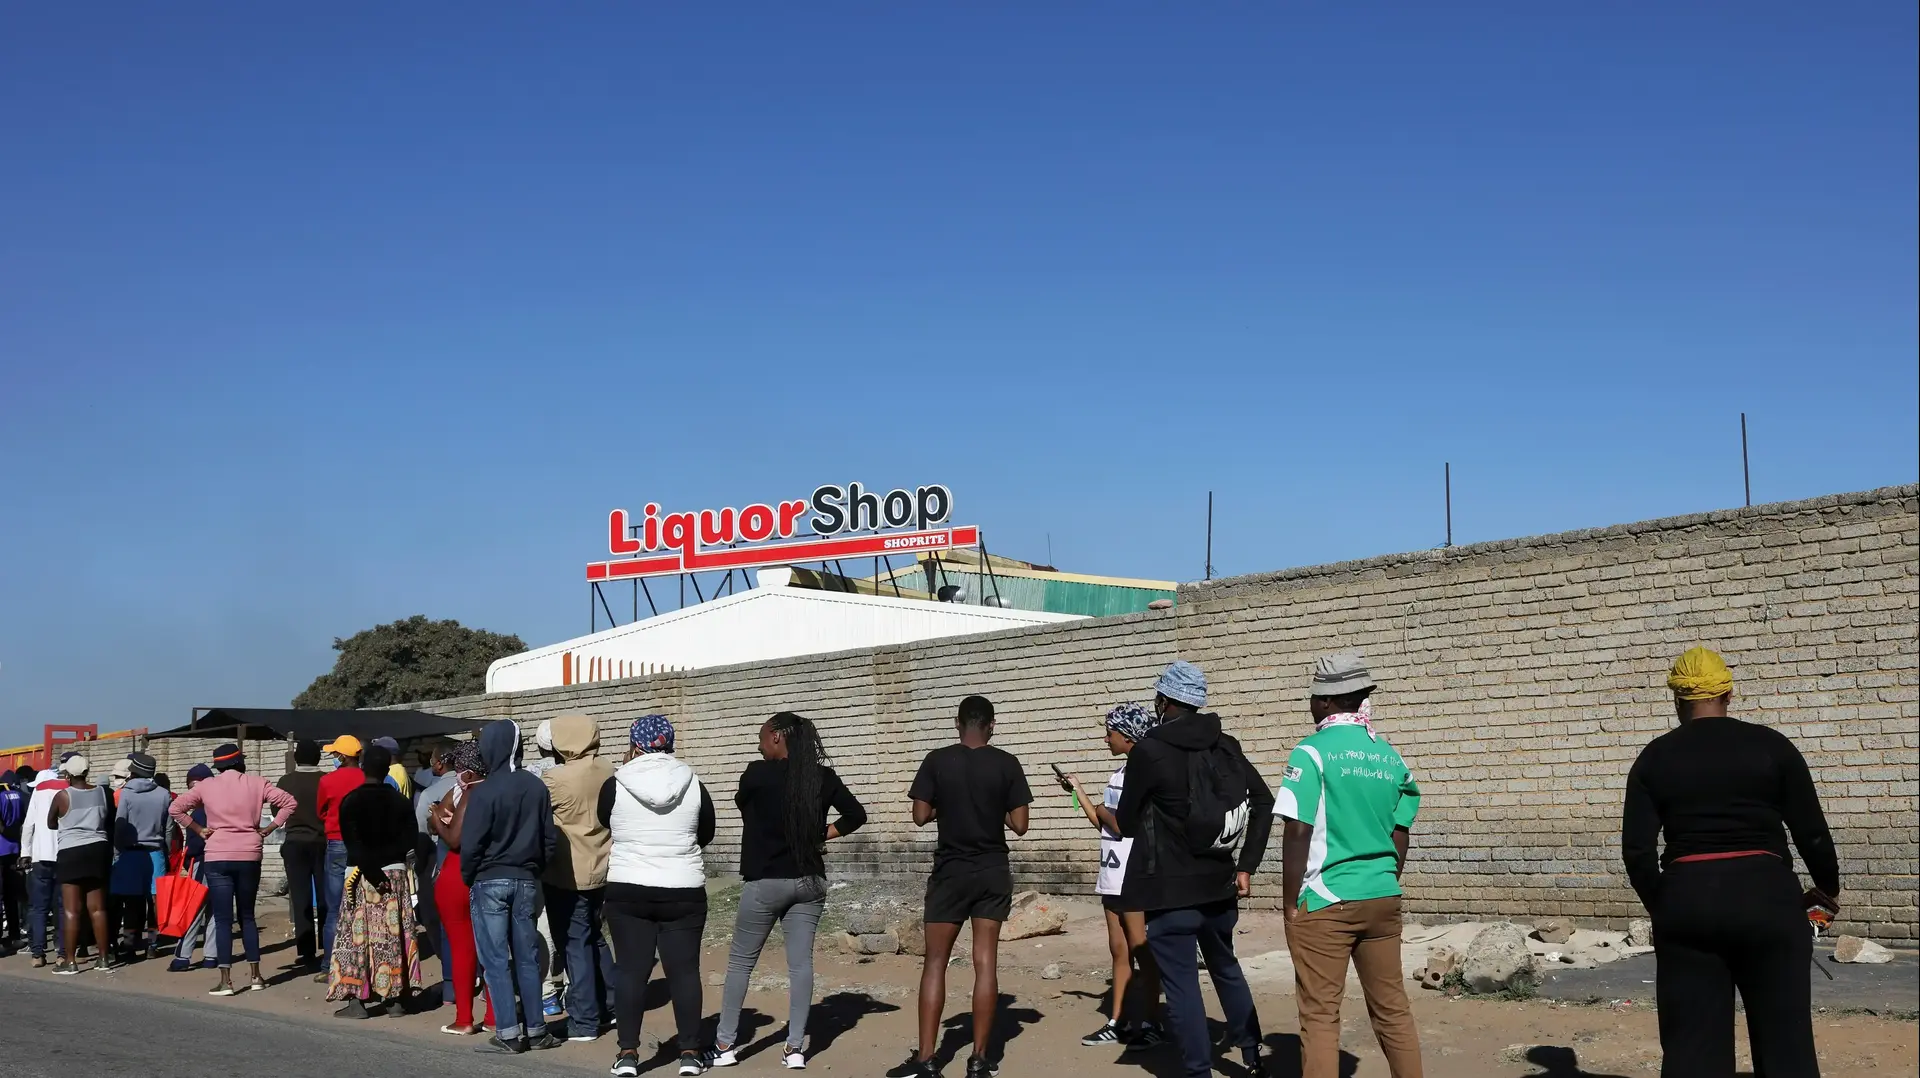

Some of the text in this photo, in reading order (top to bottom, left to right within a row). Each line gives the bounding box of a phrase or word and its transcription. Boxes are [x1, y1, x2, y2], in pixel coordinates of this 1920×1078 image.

[884, 534, 946, 549] SHOPRITE
[1344, 750, 1365, 760] PROUD
[1364, 767, 1383, 779] World
